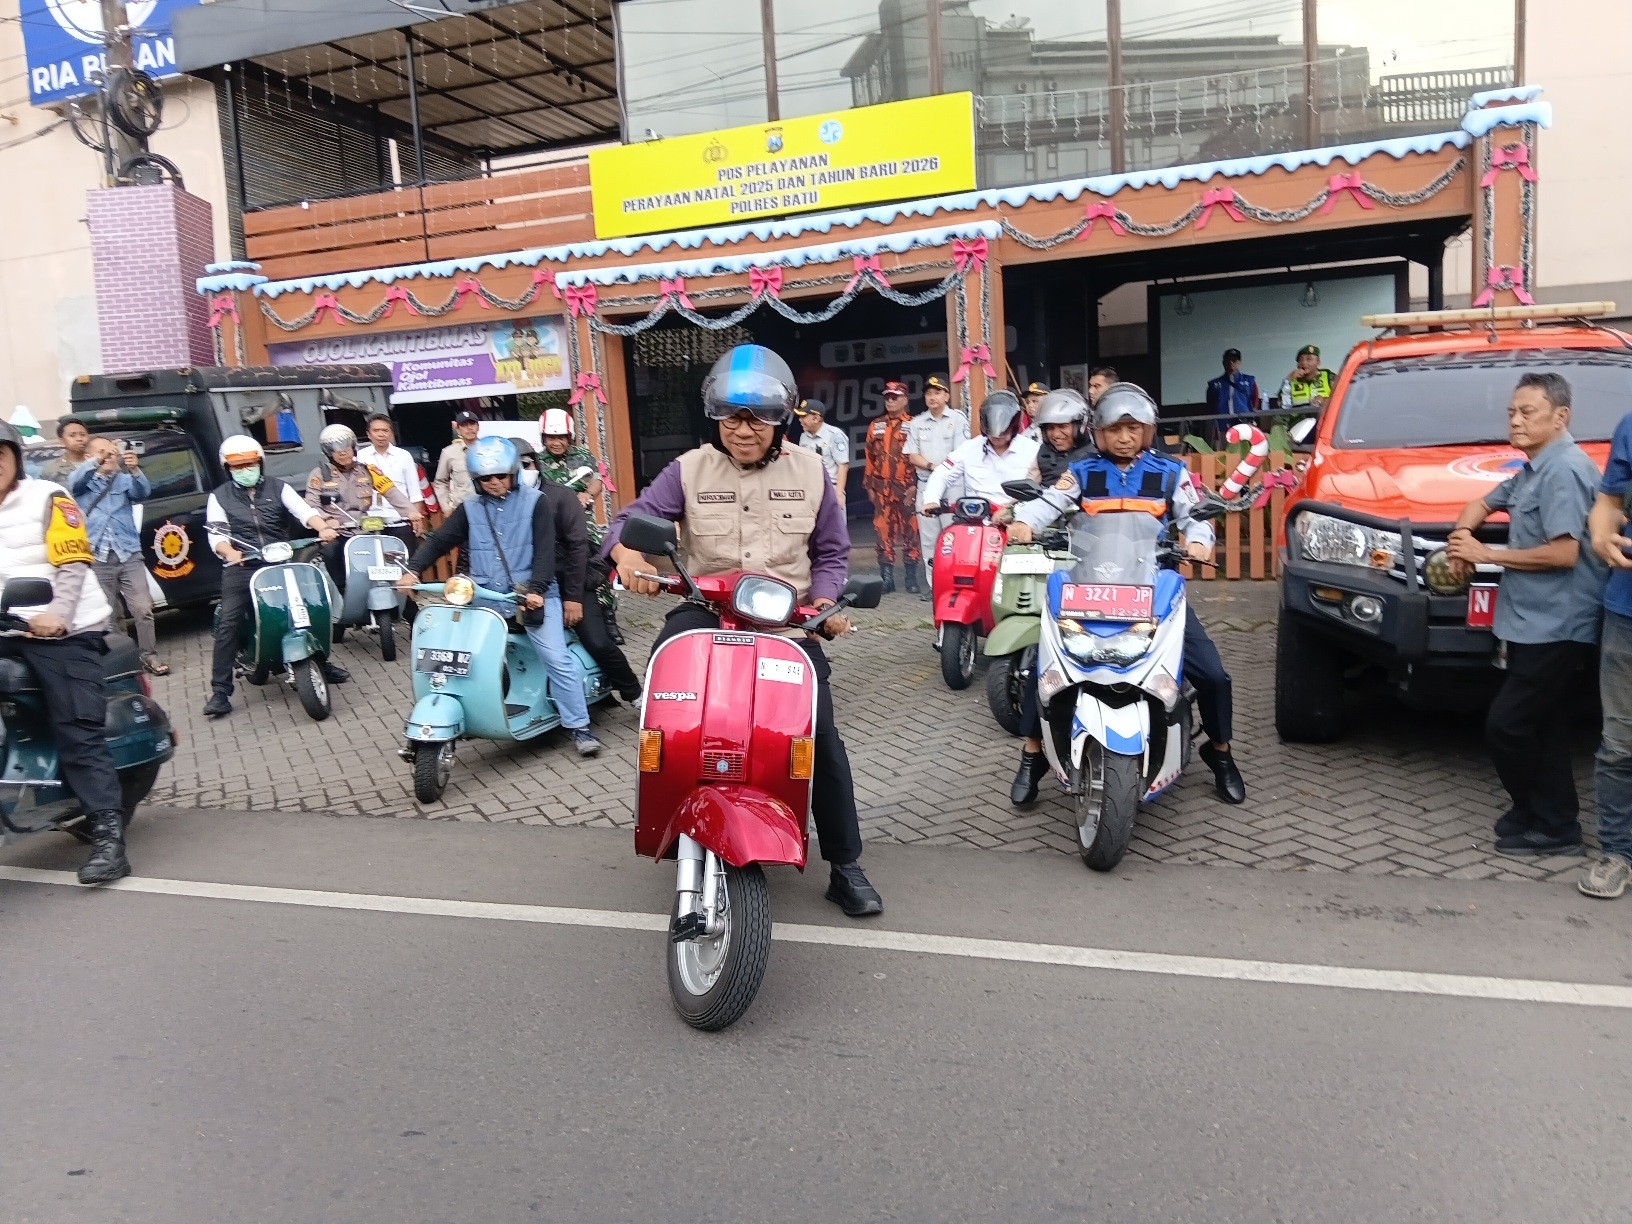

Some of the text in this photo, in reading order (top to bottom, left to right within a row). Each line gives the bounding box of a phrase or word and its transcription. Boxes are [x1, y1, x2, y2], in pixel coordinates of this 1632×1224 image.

[31, 61, 80, 94] RIA
[717, 153, 829, 181] POS PELAYANAN
[622, 157, 939, 213] PERAYAAN NATAL 2025 DAN TAHUN BARU 2026
[730, 191, 819, 214] POLRES BATU
[400, 356, 475, 373] Komunitas
[397, 377, 473, 391] Kamtibmas
[399, 371, 428, 382] Ojol
[1064, 586, 1075, 601] N
[1131, 588, 1150, 603] JP
[1473, 590, 1490, 613] N
[653, 691, 698, 701] vespa
